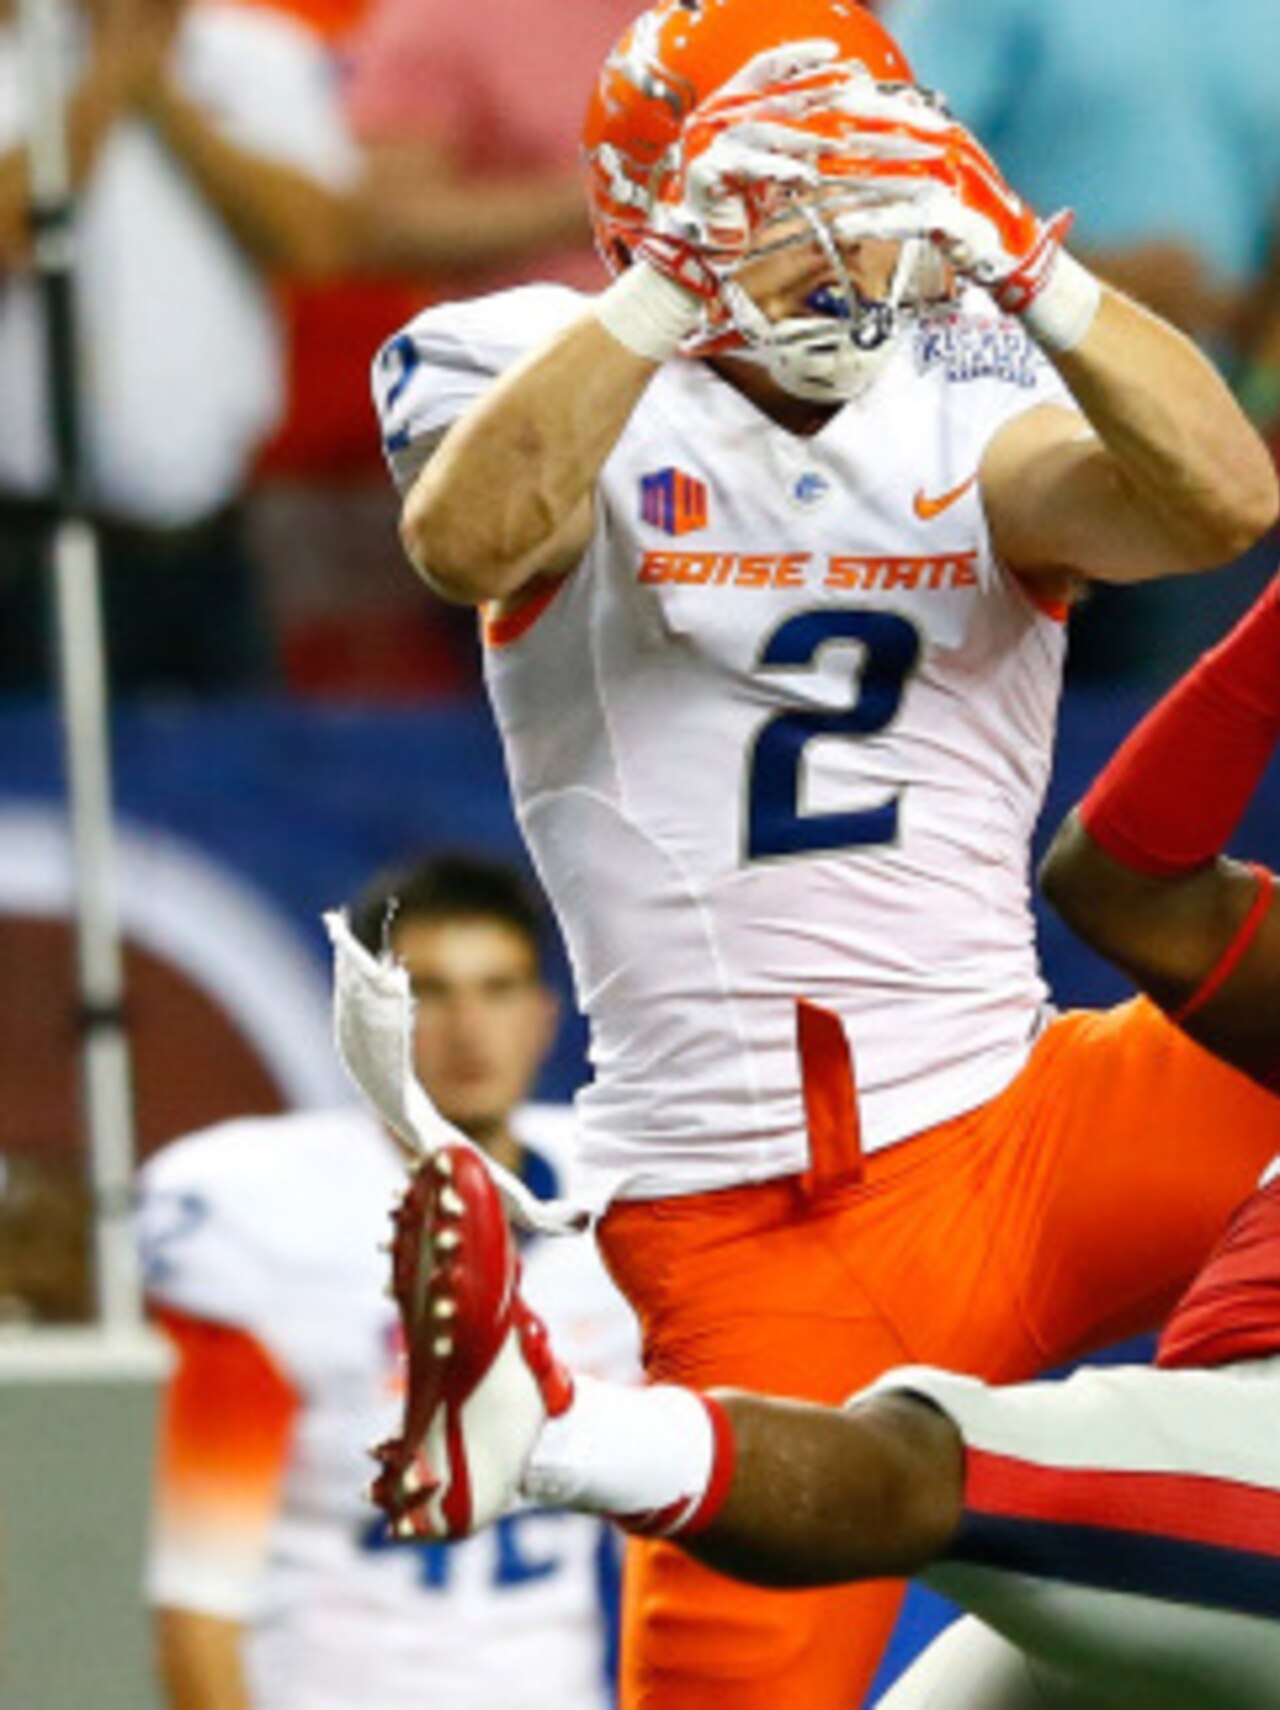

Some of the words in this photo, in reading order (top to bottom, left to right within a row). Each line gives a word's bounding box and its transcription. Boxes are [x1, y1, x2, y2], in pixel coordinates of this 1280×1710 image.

[637, 551, 812, 588] BOISE
[823, 550, 978, 590] STATE
[742, 608, 924, 866] 2
